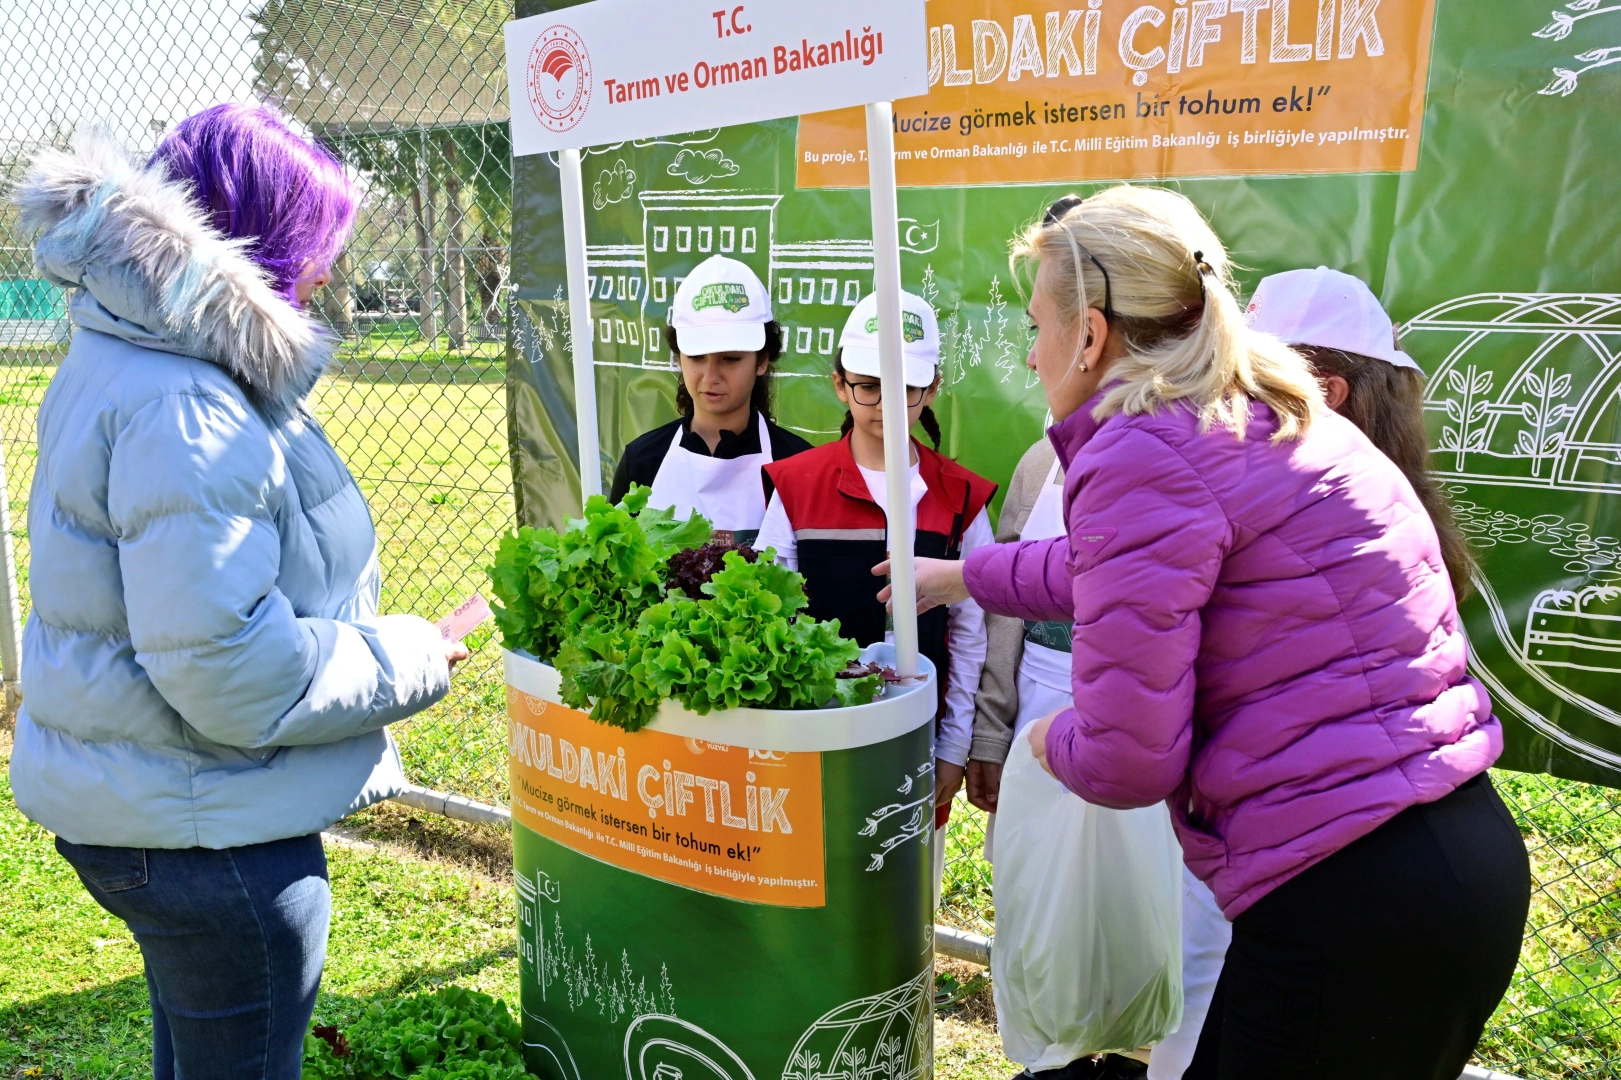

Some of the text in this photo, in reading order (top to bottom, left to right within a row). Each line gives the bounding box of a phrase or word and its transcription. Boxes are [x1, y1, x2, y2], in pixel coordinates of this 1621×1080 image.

[712, 6, 752, 38] T.C.
[604, 26, 883, 104] Tarım ve Orman Bakanlığı
[959, 101, 1036, 136] görmek
[1044, 101, 1126, 125] istersen
[1136, 92, 1170, 118] bir
[1179, 89, 1260, 116] tohum
[804, 151, 819, 163] Bu
[821, 150, 856, 165] proje,
[914, 151, 928, 159] ve
[930, 147, 970, 159] Orman
[973, 143, 1027, 157] Bakanlığı
[1032, 141, 1047, 154] ile
[1050, 140, 1071, 153] T.C.
[1074, 137, 1102, 151] Millî
[1105, 135, 1148, 152] Eğitim
[1152, 132, 1220, 148] Bakanlığı
[1228, 131, 1240, 147] iş
[1244, 130, 1314, 147] birliğiyle
[1318, 127, 1410, 146] yapılmıştır.
[507, 717, 793, 834] OKULDAKİ ÇİFTLİK
[545, 812, 564, 826] Orman
[565, 820, 593, 839] Bakanlığı
[596, 831, 604, 843] ile
[605, 834, 618, 847] T.C.
[637, 845, 662, 860] Eğitim
[663, 852, 702, 872] Bakanlığı
[705, 864, 712, 875] iş
[714, 866, 756, 883] birliğiyle
[758, 876, 818, 889] yapılmıştır.
[557, 797, 597, 821] görmek
[601, 809, 647, 836] istersen
[653, 822, 671, 843] bir
[676, 832, 721, 856] tohum
